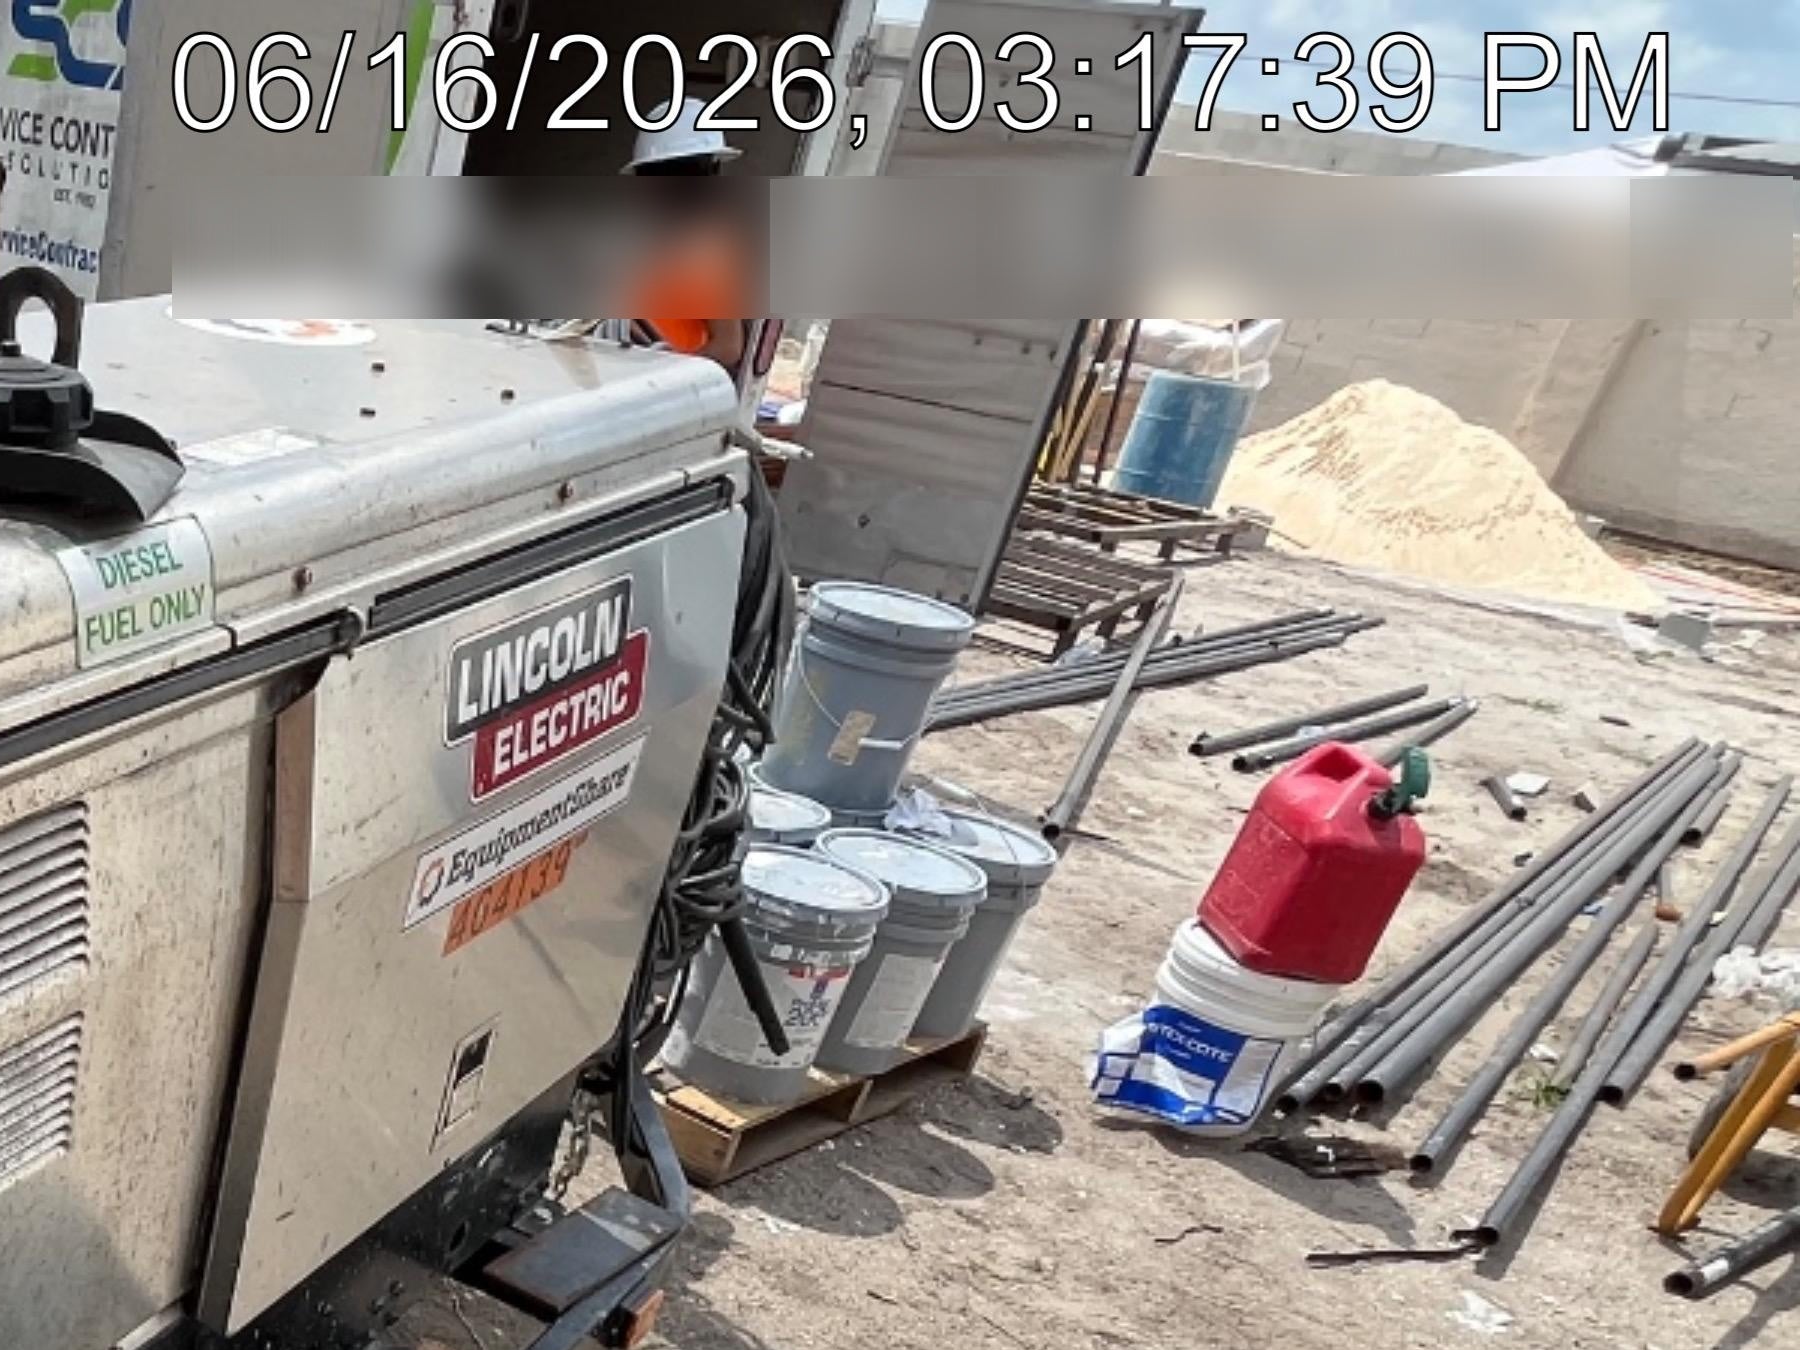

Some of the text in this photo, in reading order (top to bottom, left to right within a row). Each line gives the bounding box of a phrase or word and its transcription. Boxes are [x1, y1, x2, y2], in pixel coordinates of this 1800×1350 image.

[86, 583, 205, 650] FUEL ONLY
[96, 540, 183, 589] DIESEL
[457, 594, 625, 725] LINCOLN
[492, 670, 631, 777] ELECTRIC
[446, 762, 633, 886] EquipmentShare
